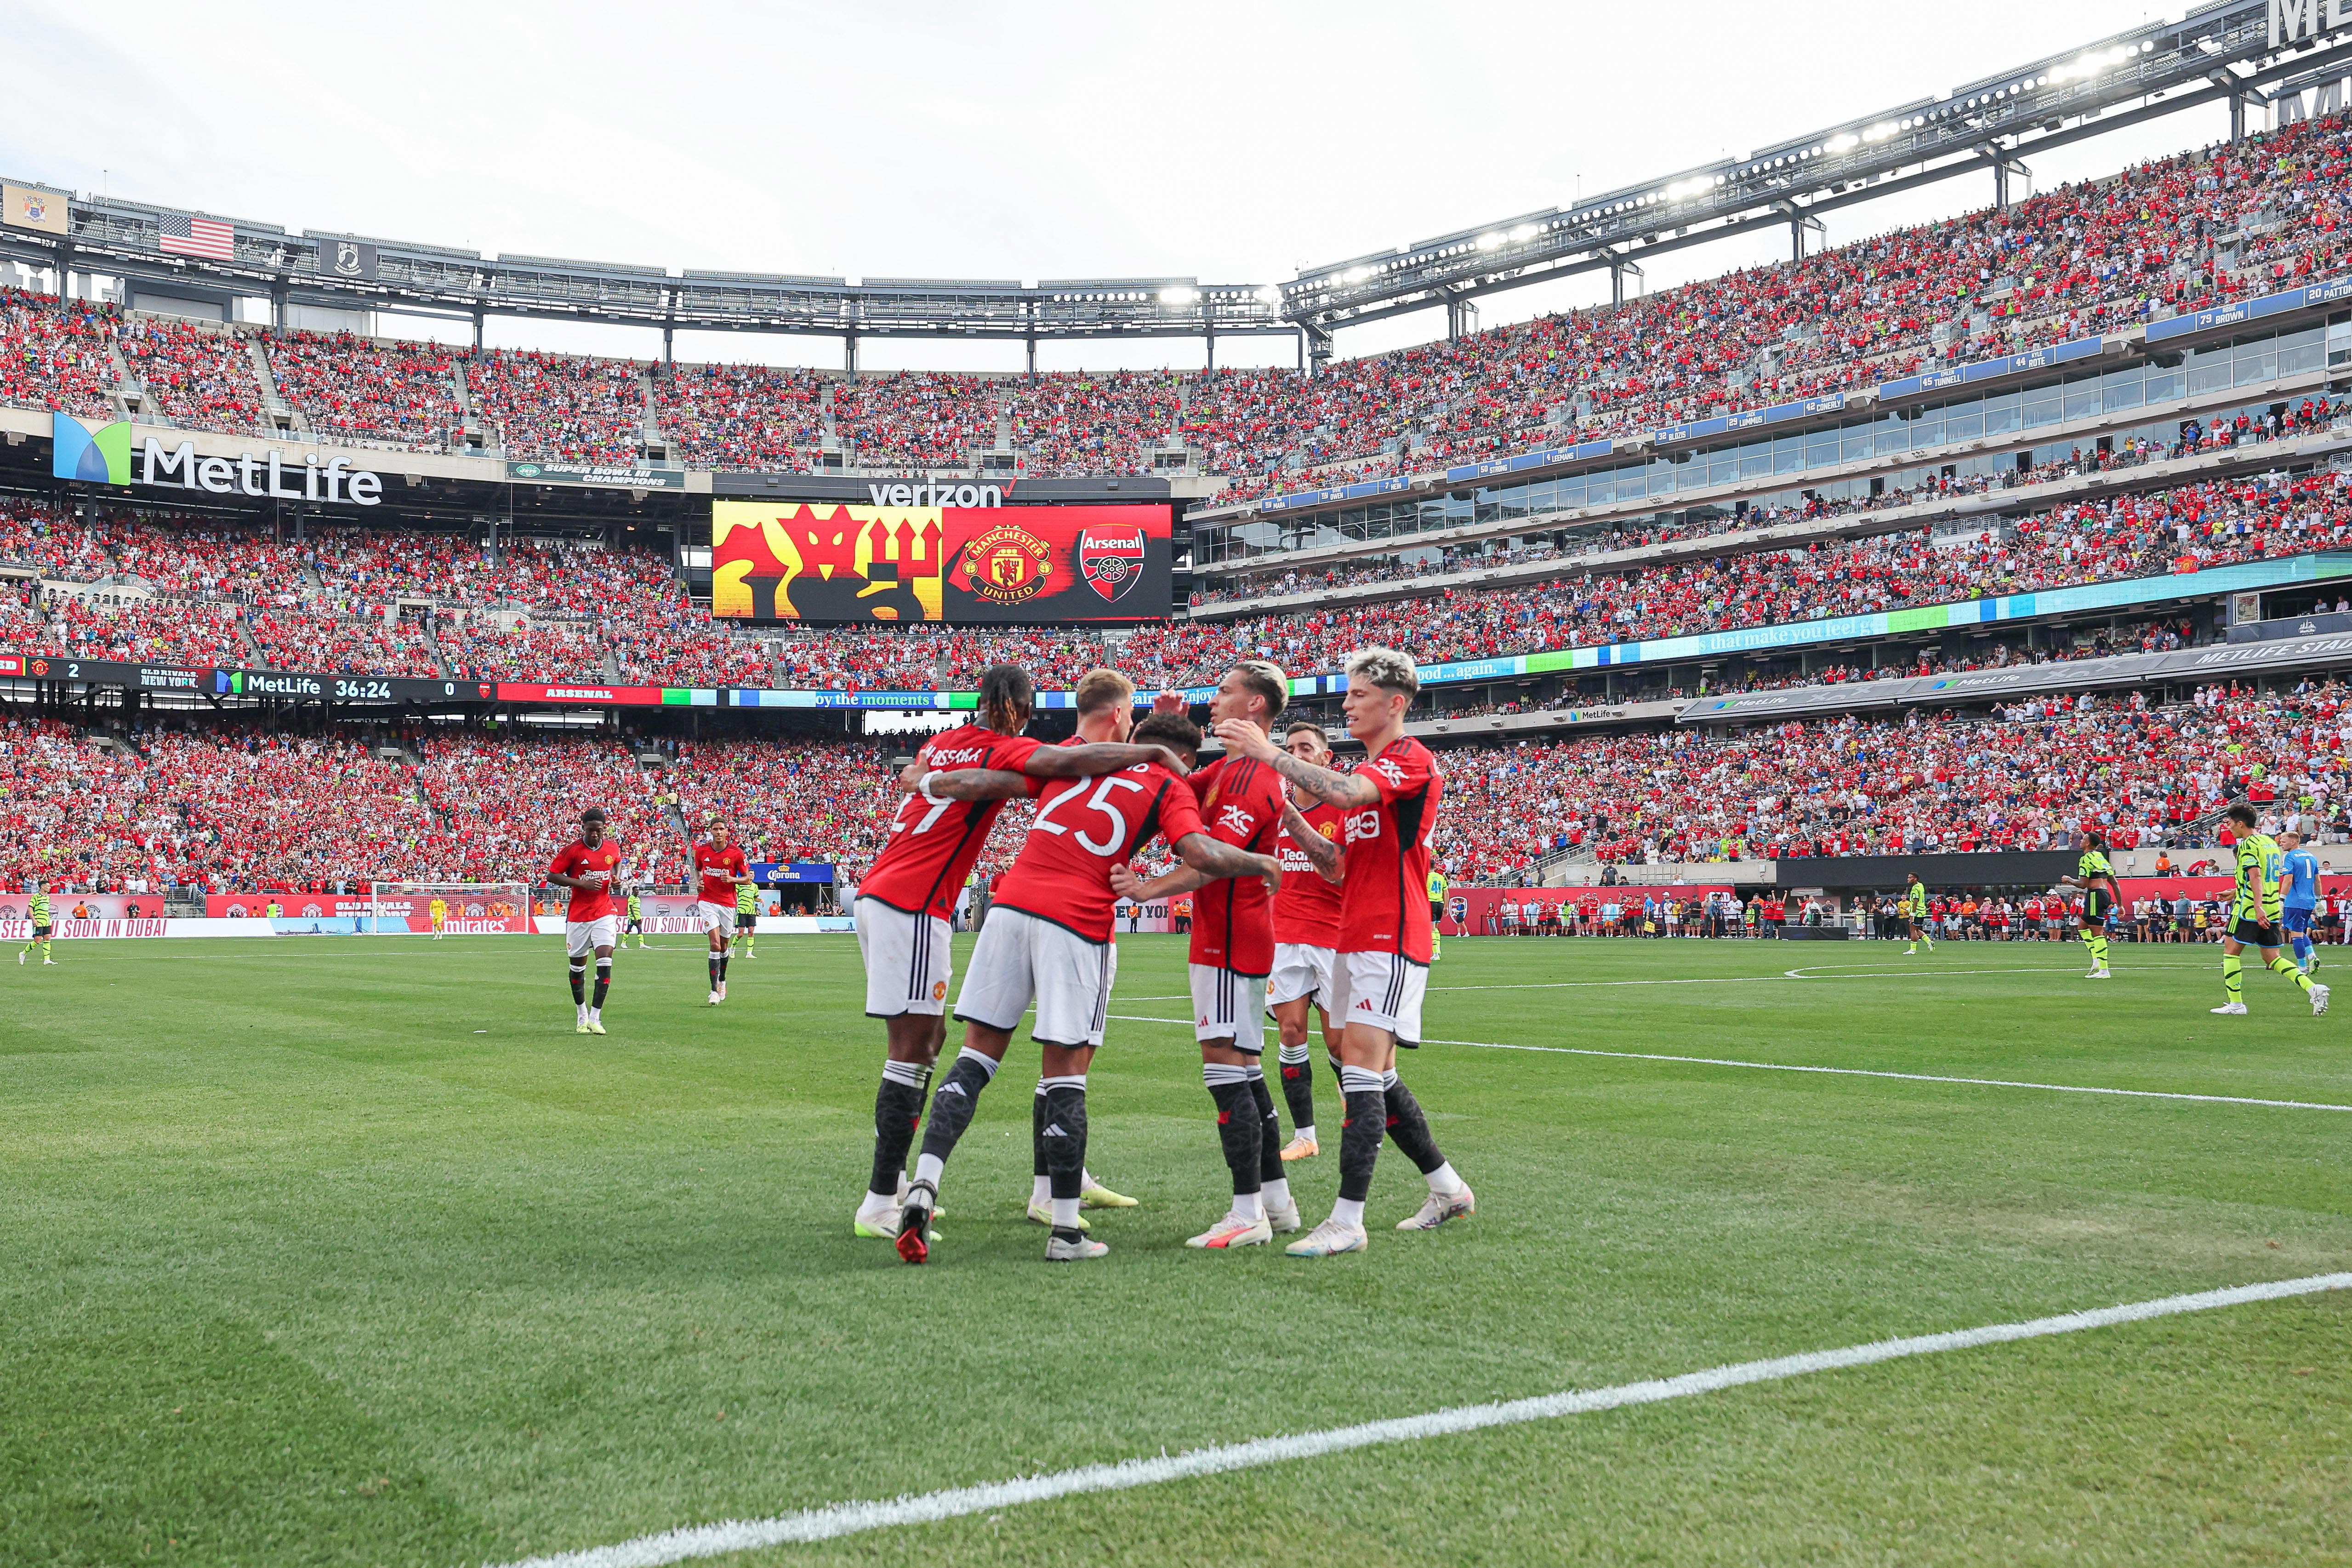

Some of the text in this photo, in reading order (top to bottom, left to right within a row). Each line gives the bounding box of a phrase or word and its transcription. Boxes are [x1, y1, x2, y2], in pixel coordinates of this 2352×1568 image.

[2330, 278, 2348, 288] JIMMY
[2309, 284, 2352, 300] 20 PATTON
[2222, 305, 2236, 314] ROSIE
[2200, 310, 2244, 325] 79 BROWN
[2016, 357, 2045, 368] 44 ROTE
[1923, 374, 1961, 387] 45 TUNNELL
[1806, 399, 1841, 412] 42 CONERLY
[1729, 416, 1763, 427] 29 LUMMUS
[1658, 431, 1686, 441] 32 BLOZIS
[1552, 452, 1574, 462] LEEMANS
[143, 437, 383, 506] MetLife
[544, 464, 591, 474] SUPER
[592, 467, 633, 477] BOWL
[1481, 464, 1508, 474] 50 STRONG
[582, 474, 666, 486] CHAMPIONS
[868, 477, 1002, 508] verizon
[1391, 483, 1401, 491] HEIN
[1330, 492, 1344, 500] OWEN
[971, 530, 1043, 558] MANCHESTER
[1083, 536, 1140, 550] Arsenal
[983, 584, 1034, 601] UNITED
[1710, 635, 1741, 650] that
[1744, 627, 1788, 646] make
[1789, 626, 1822, 644] you
[1825, 620, 1856, 636] feel
[2195, 644, 2296, 664] METLIFE
[68, 663, 79, 678] 2
[160, 670, 199, 678] RIVALS.
[1416, 666, 1442, 681] ood
[1456, 661, 1498, 680] again.
[141, 675, 199, 688] NEW YORK.
[248, 675, 321, 695] MetLife
[1957, 675, 2020, 687] MetLife
[335, 680, 391, 699] 36:24
[445, 682, 455, 695] 0
[546, 688, 613, 699] ARSENAL
[815, 695, 833, 707] oy
[835, 694, 859, 706] the
[861, 695, 929, 706] moments
[1181, 689, 1213, 705] Enjoy
[1734, 697, 1788, 707] MetLife
[1582, 710, 1611, 719] MetLife
[1031, 775, 1144, 857] 25
[2265, 853, 2280, 883] 18
[2305, 858, 2312, 878] 1
[767, 871, 800, 882] Corona
[1431, 880, 1441, 895] 41
[335, 901, 415, 910] OLD RALS.
[1, 920, 28, 938] SEE
[63, 920, 101, 938] SOON
[106, 920, 121, 937] IN
[125, 919, 167, 936] DUBAI
[444, 916, 510, 933] mirates®
[616, 917, 632, 933] SE
[661, 917, 689, 932] SOON
[692, 917, 704, 932] IN
